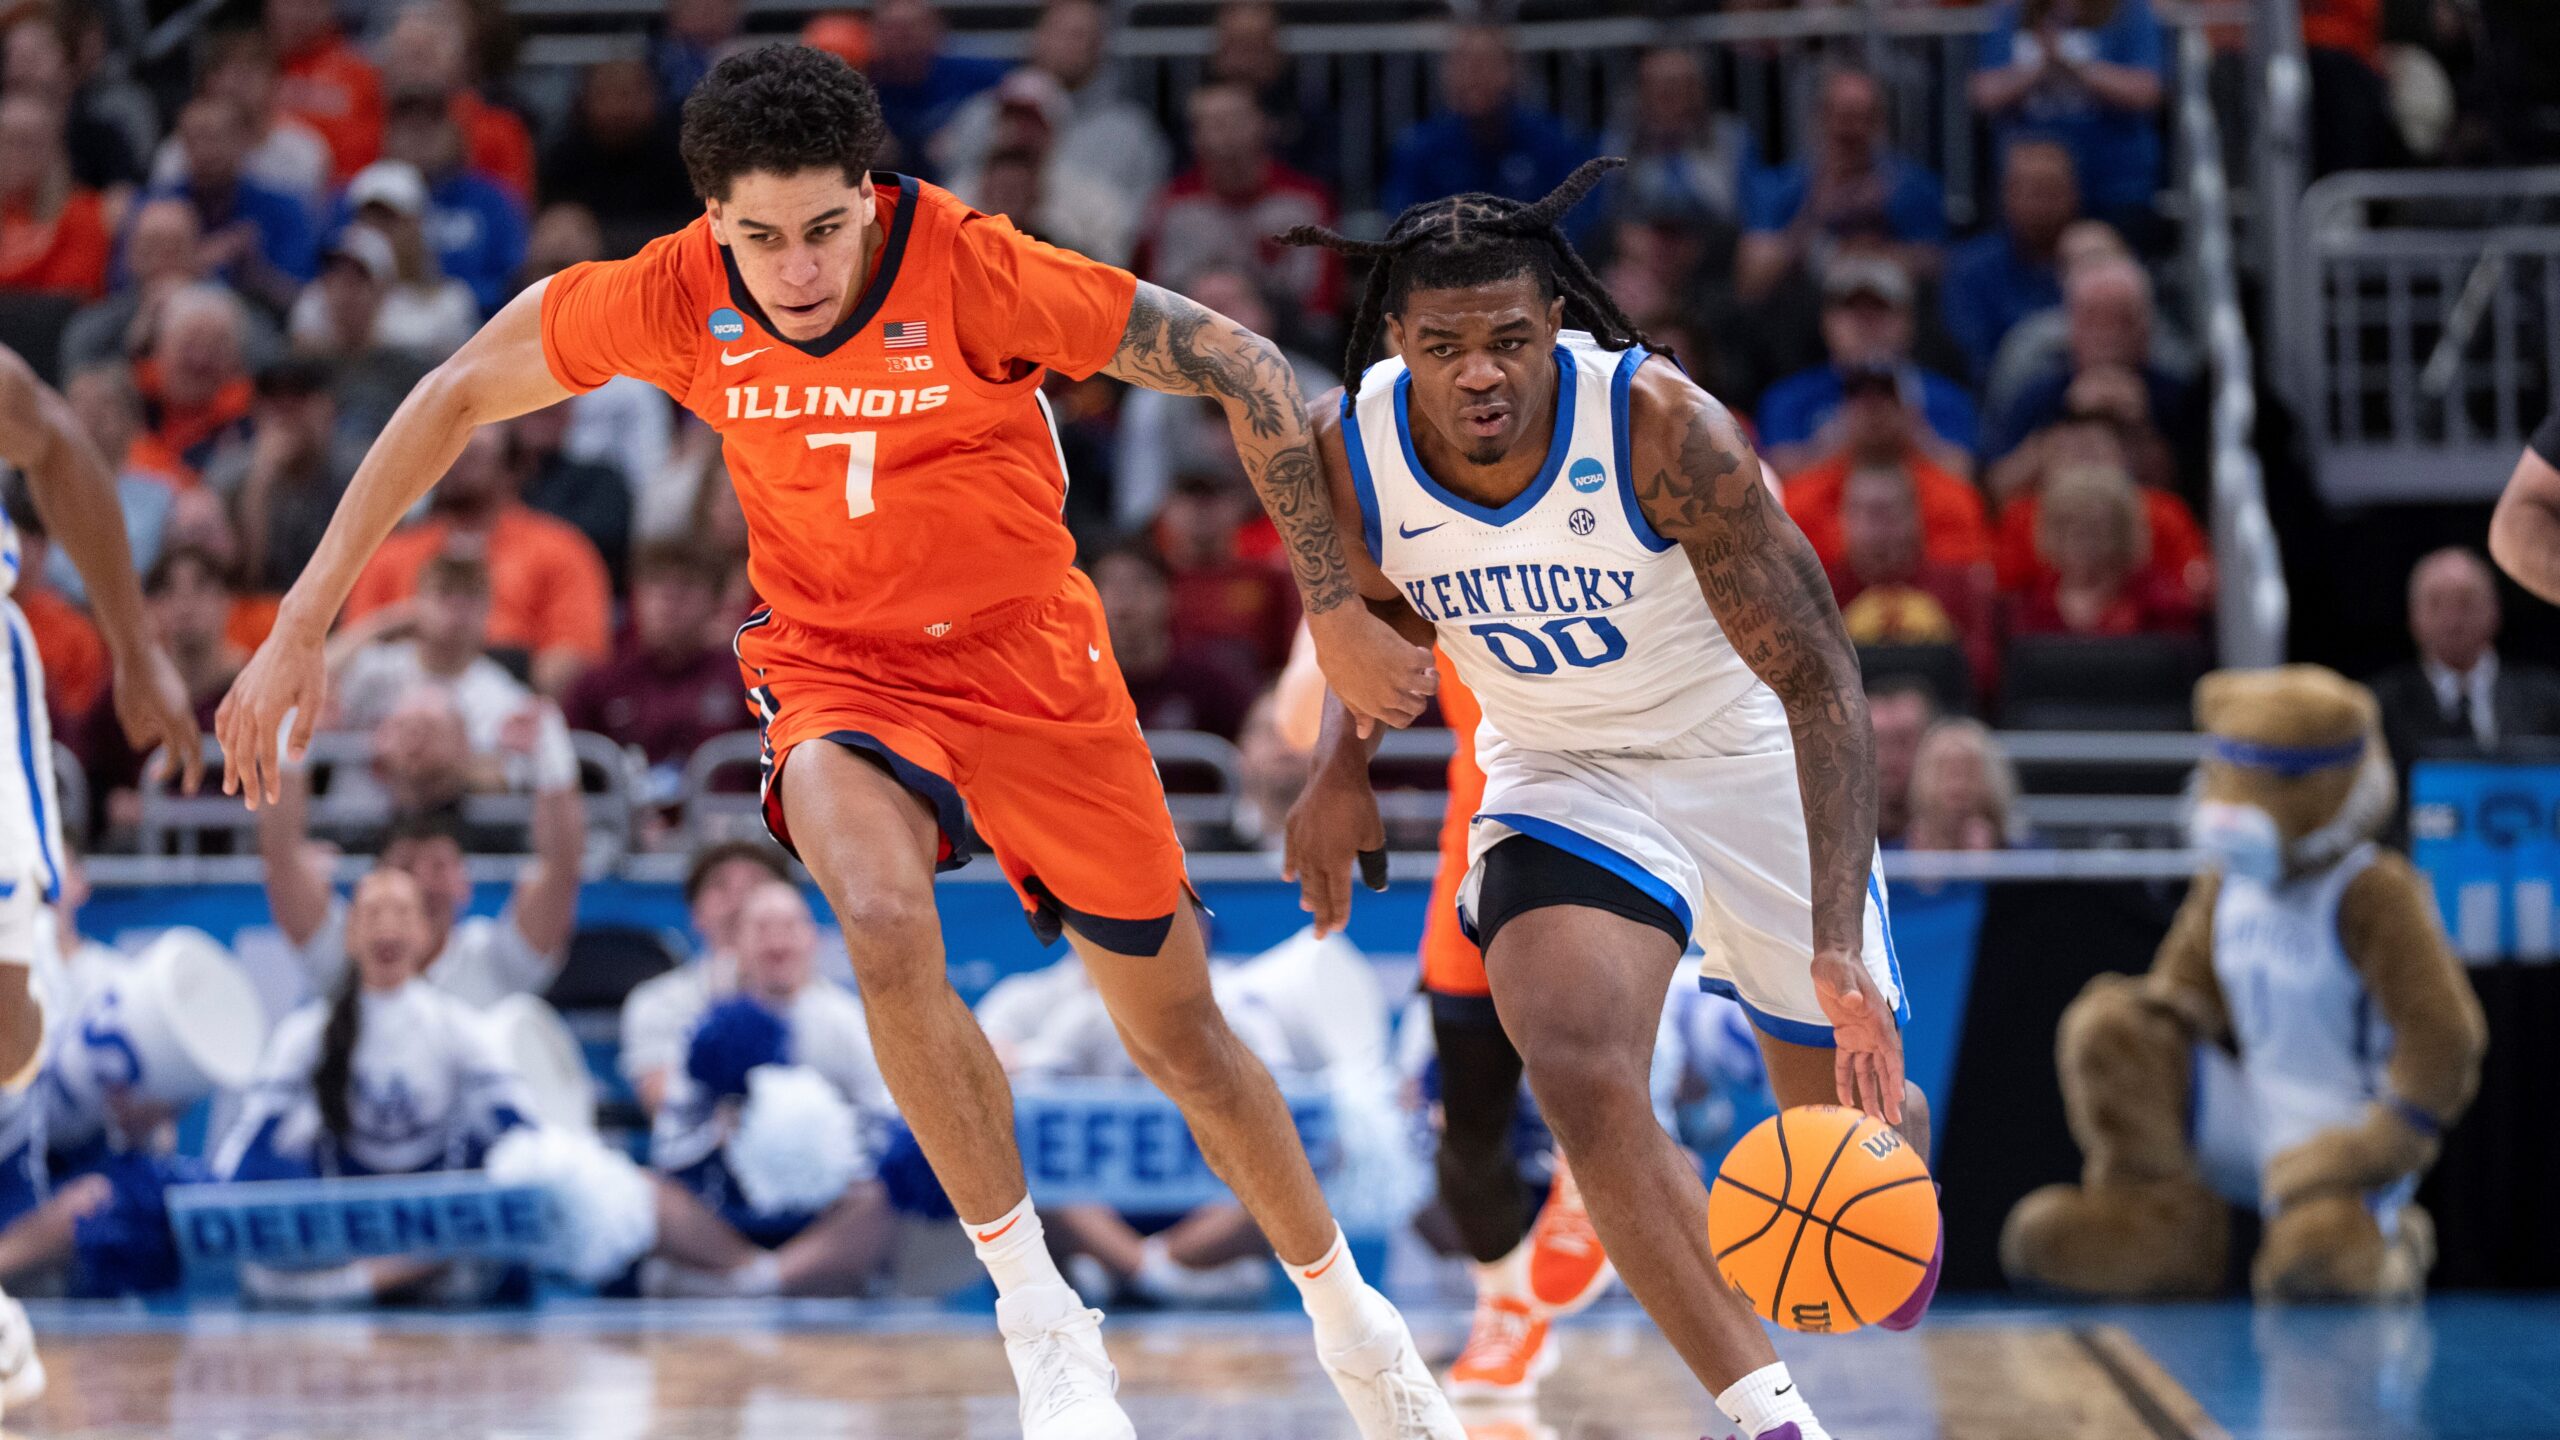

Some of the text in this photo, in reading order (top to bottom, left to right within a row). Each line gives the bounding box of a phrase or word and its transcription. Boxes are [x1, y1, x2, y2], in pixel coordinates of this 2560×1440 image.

[713, 323, 744, 335] NCAA
[725, 384, 950, 419] ILLINOIS
[804, 431, 877, 520] 7
[1574, 472, 1604, 487] NCAA
[1569, 510, 1595, 535] SEC
[1405, 563, 1635, 621] KENTUCKY
[1469, 615, 1628, 675] 00
